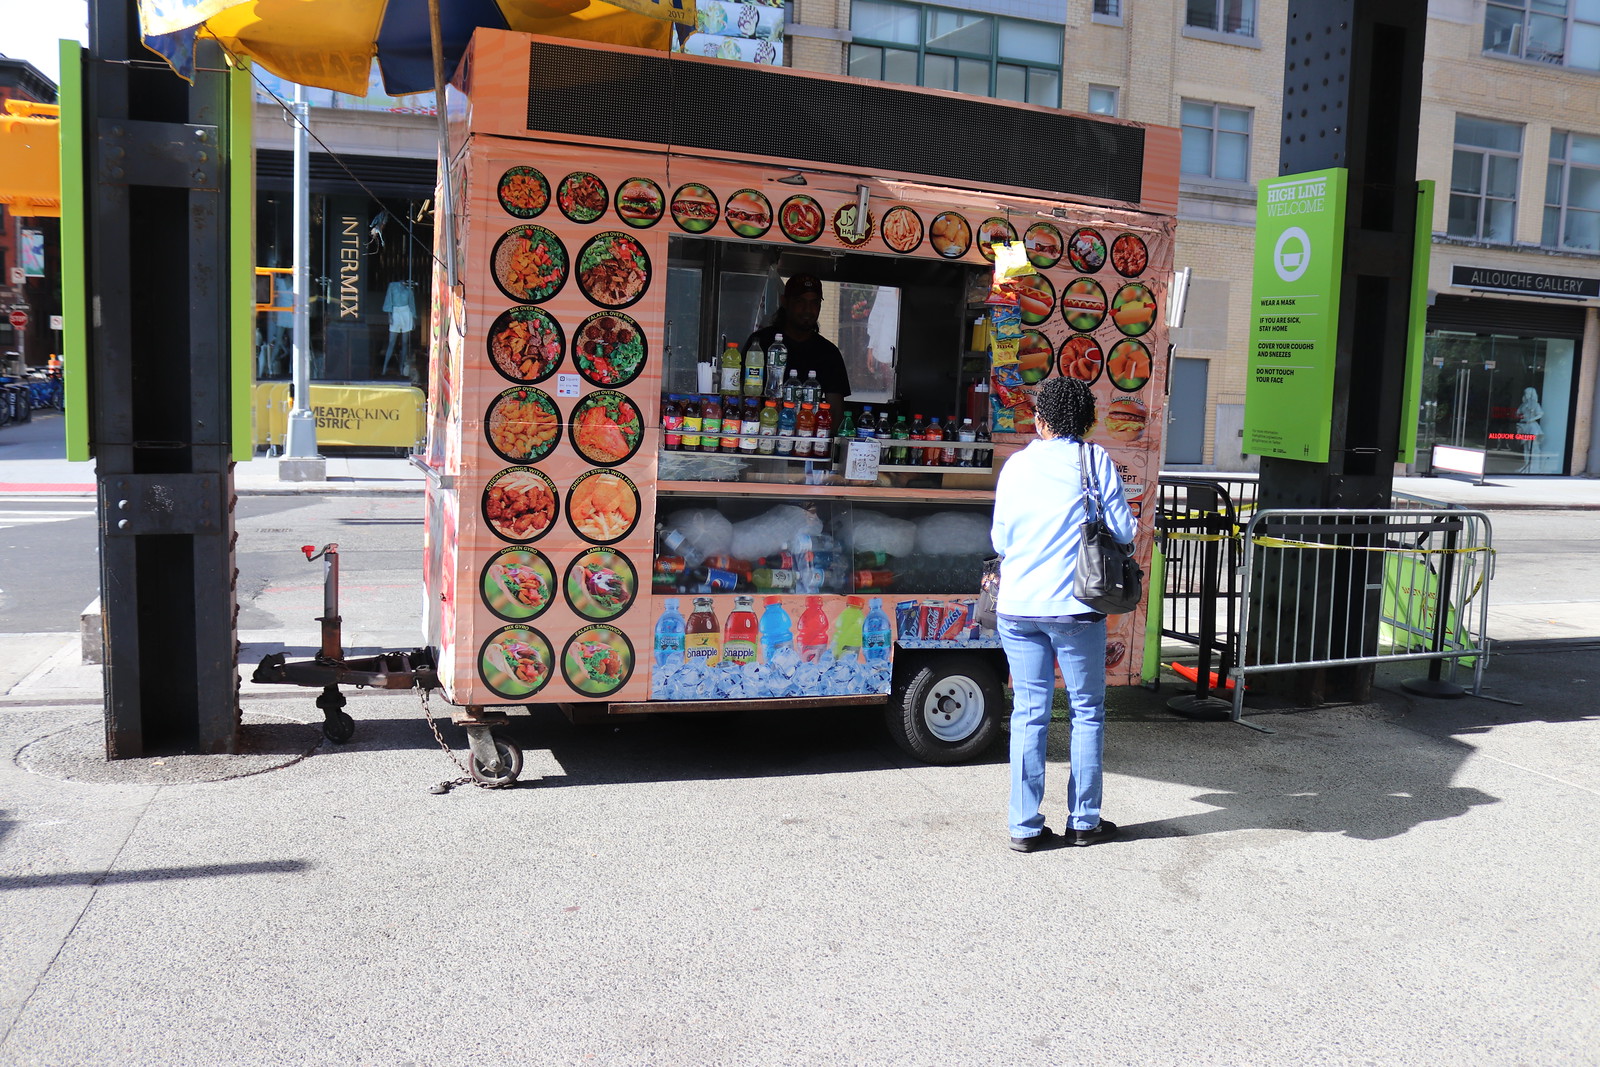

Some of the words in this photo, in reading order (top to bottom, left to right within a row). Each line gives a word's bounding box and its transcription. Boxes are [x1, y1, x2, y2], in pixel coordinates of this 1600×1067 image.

[668, 10, 685, 20] 2017
[1267, 187, 1296, 203] HIGH
[1298, 183, 1326, 199] LINE
[1267, 198, 1324, 216] WELCOME
[507, 225, 528, 236] CHICKEN
[545, 229, 557, 239] RICE
[624, 234, 636, 243] RICE
[340, 216, 359, 318] INTERMIX
[1471, 271, 1532, 288] ALLOUCHE
[1535, 276, 1583, 292] GALLERY
[534, 307, 546, 315] RICE
[588, 311, 608, 322] FALAFEL
[623, 314, 635, 324] RICE
[501, 387, 521, 396] SHRIMP
[537, 389, 548, 399] RICE
[589, 390, 600, 398] FISH
[614, 391, 627, 400] RICE
[310, 406, 399, 420] MEATPACKING
[315, 417, 362, 430] ISTRICT
[486, 469, 507, 491] CHICKEN
[529, 467, 544, 479] WITH
[544, 476, 557, 493] FRIES
[571, 470, 591, 490] CHICKEN
[611, 469, 624, 480] WITH
[624, 478, 637, 492] FRIES
[501, 546, 523, 554] CHICKEN
[524, 546, 538, 555] GYRO
[575, 625, 595, 637] FALAFEL
[596, 624, 622, 636] SANDWICH
[687, 648, 718, 659] Snapple
[724, 648, 754, 659] Snapple
